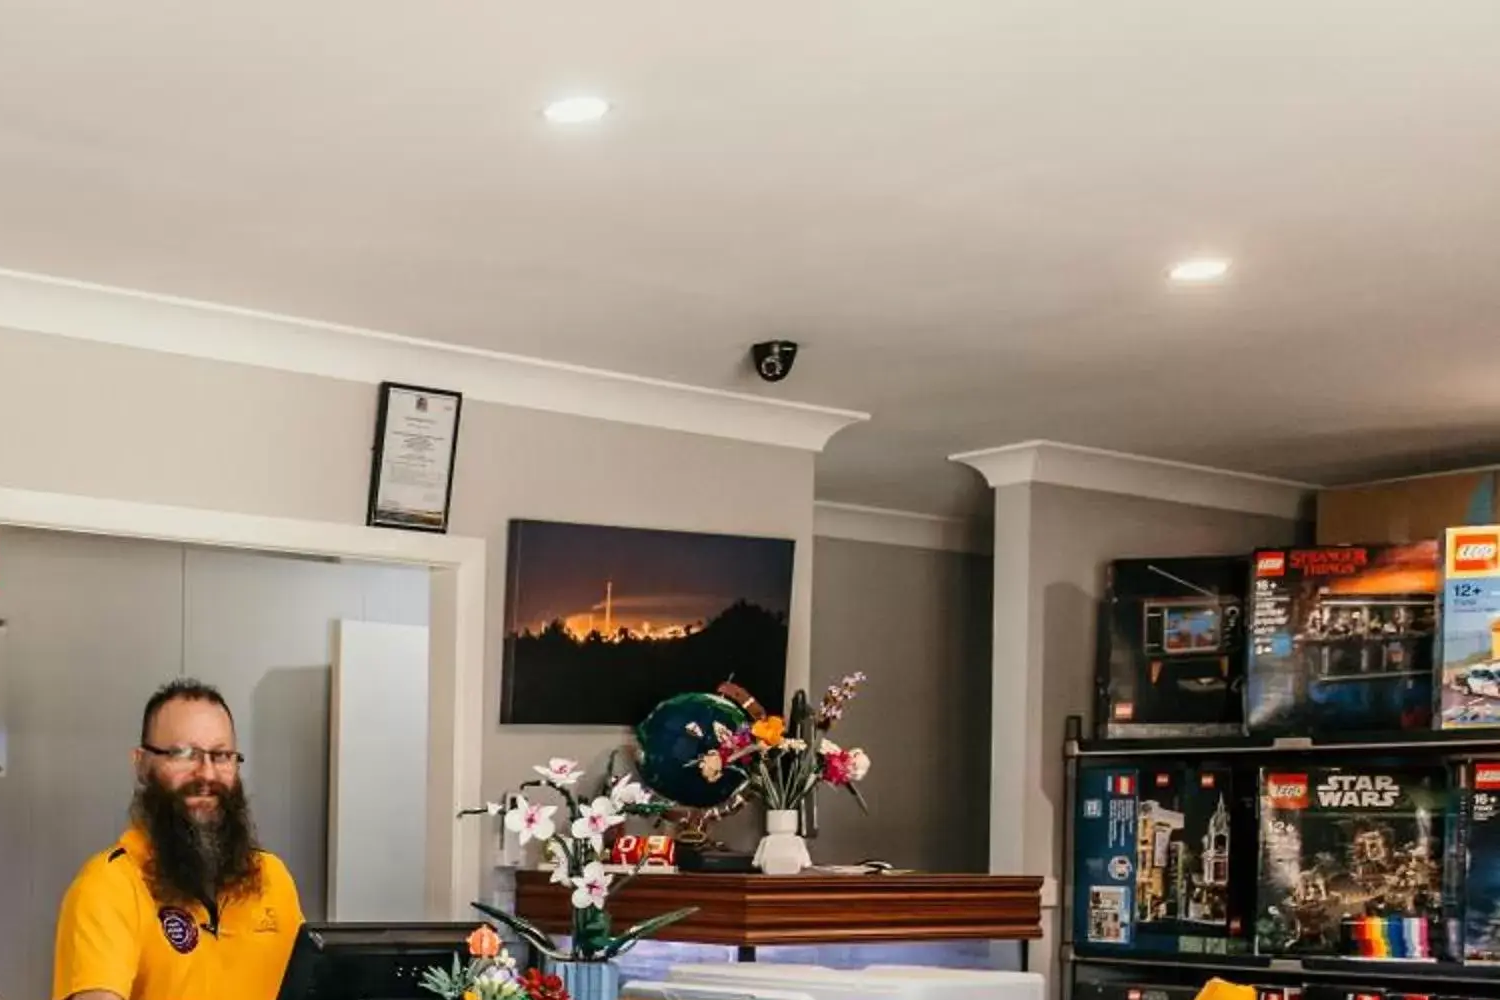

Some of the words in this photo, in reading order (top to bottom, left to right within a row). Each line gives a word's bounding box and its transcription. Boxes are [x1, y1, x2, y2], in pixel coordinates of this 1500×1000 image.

[1454, 543, 1497, 560] LEGO
[1453, 583, 1482, 597] 12+
[1317, 775, 1399, 791] STAR
[1318, 791, 1399, 807] WARS
